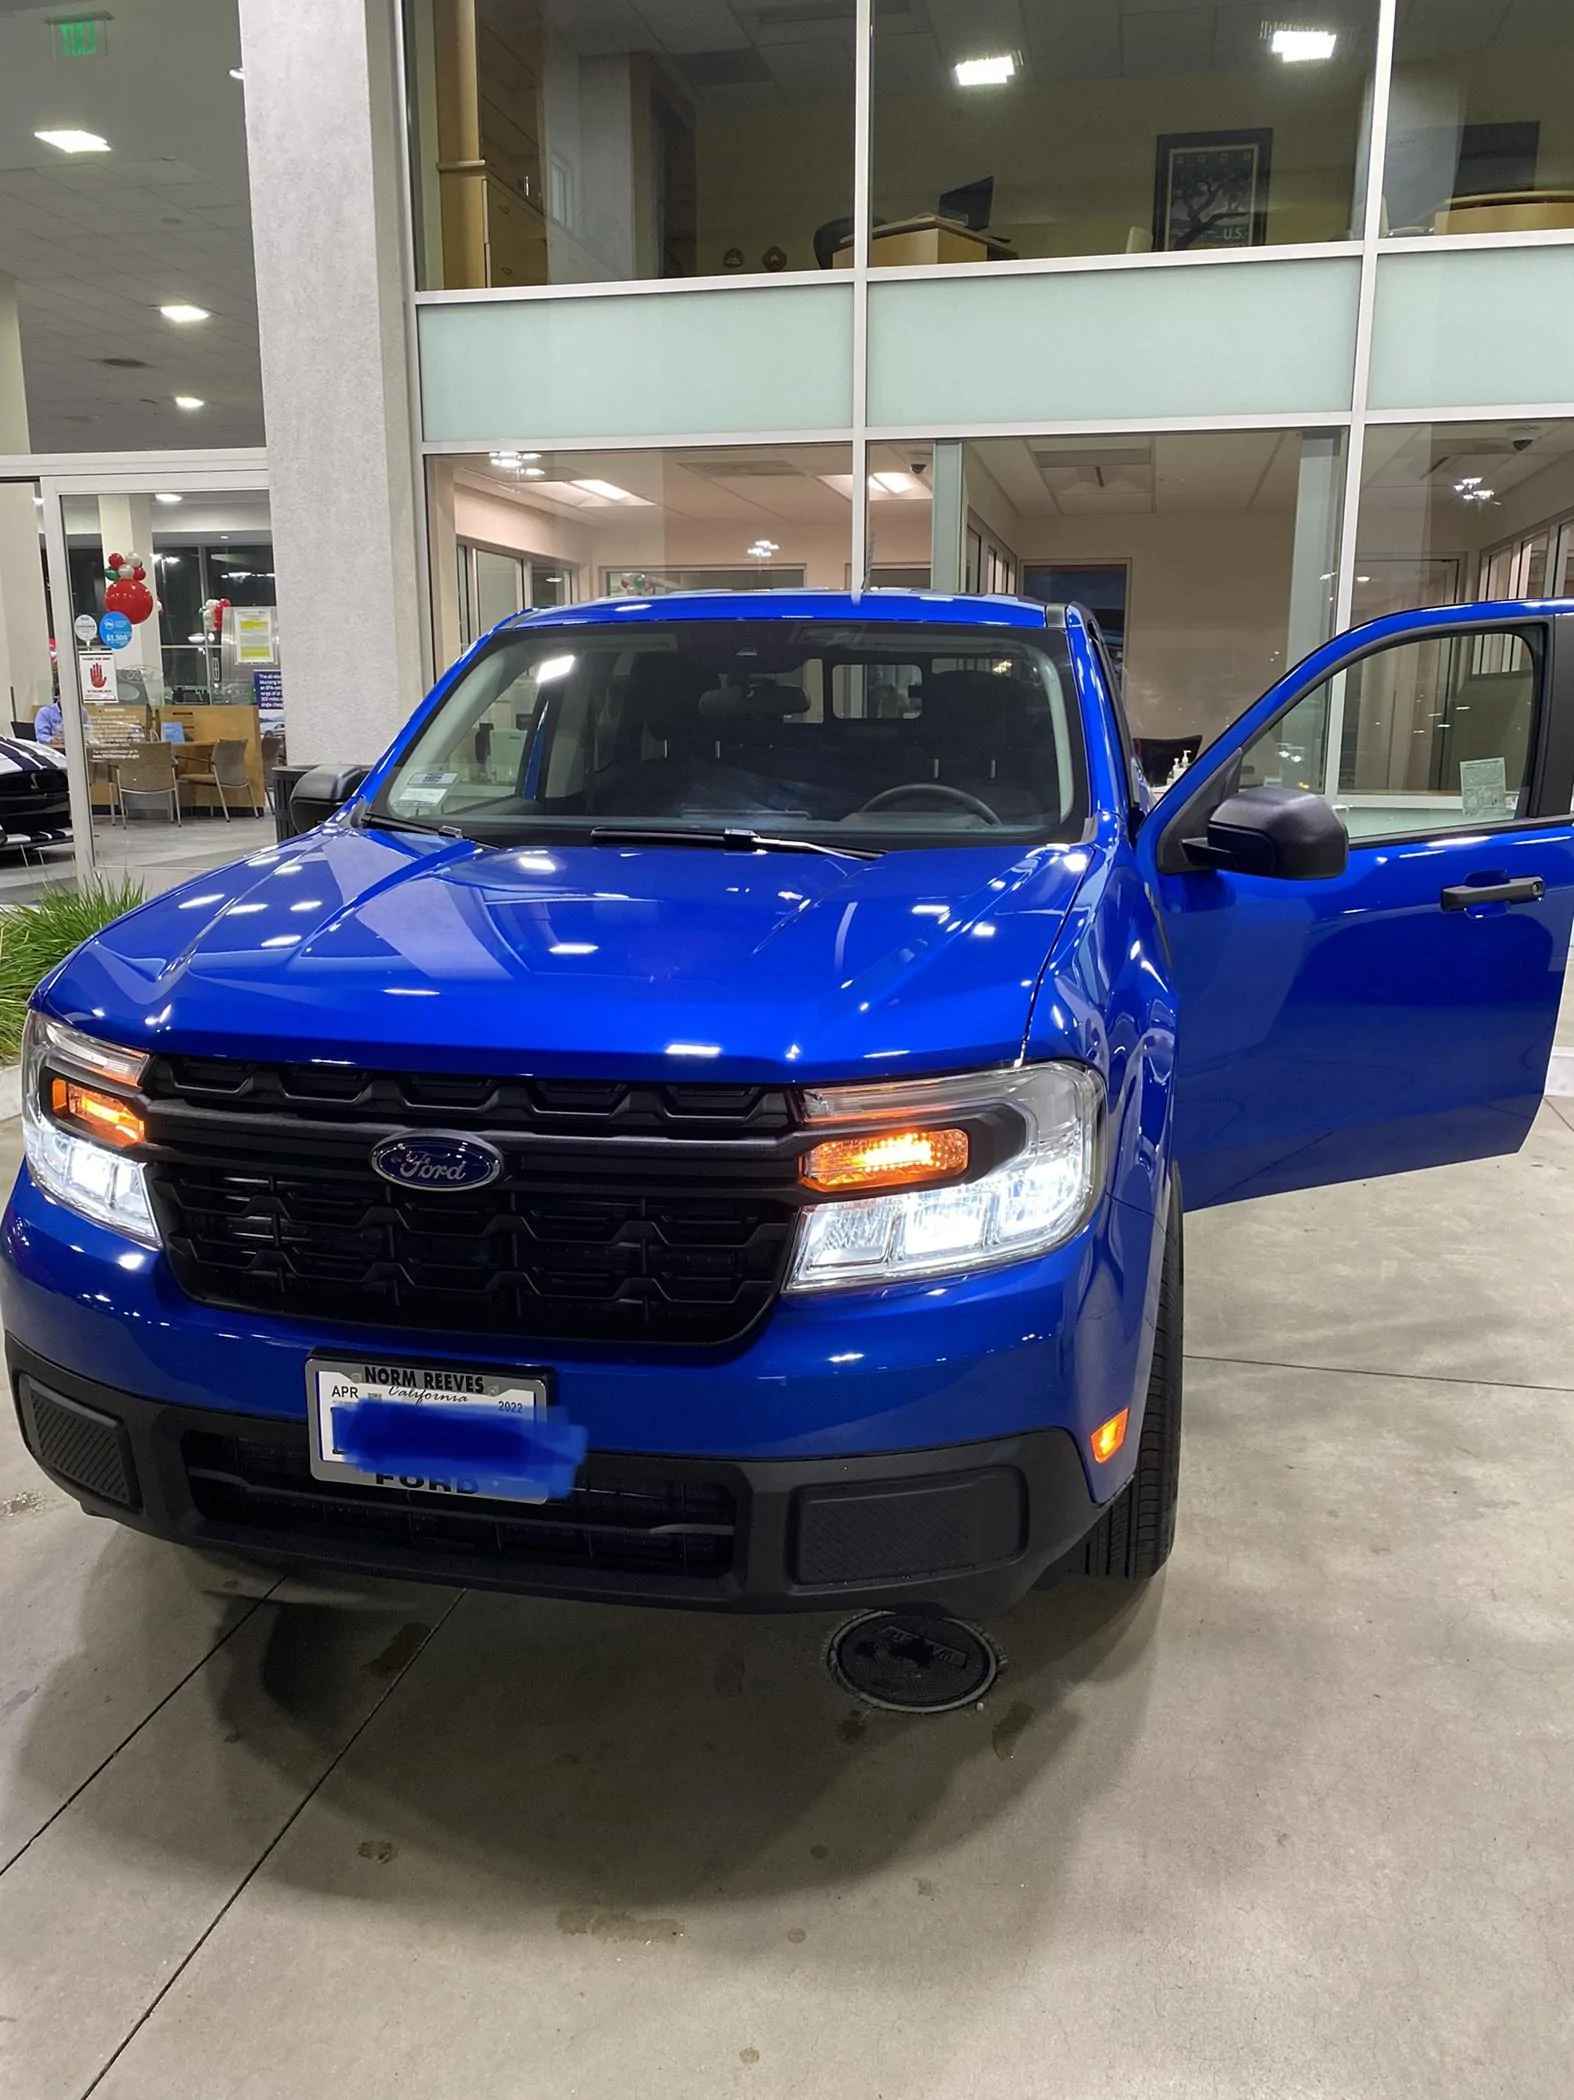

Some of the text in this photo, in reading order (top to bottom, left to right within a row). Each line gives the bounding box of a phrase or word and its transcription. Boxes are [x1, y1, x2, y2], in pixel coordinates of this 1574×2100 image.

[399, 1150, 467, 1180] Ford
[364, 1366, 485, 1394] NORM REEVES
[331, 1385, 359, 1399] APR
[388, 1386, 469, 1405] California
[498, 1400, 524, 1414] 2022
